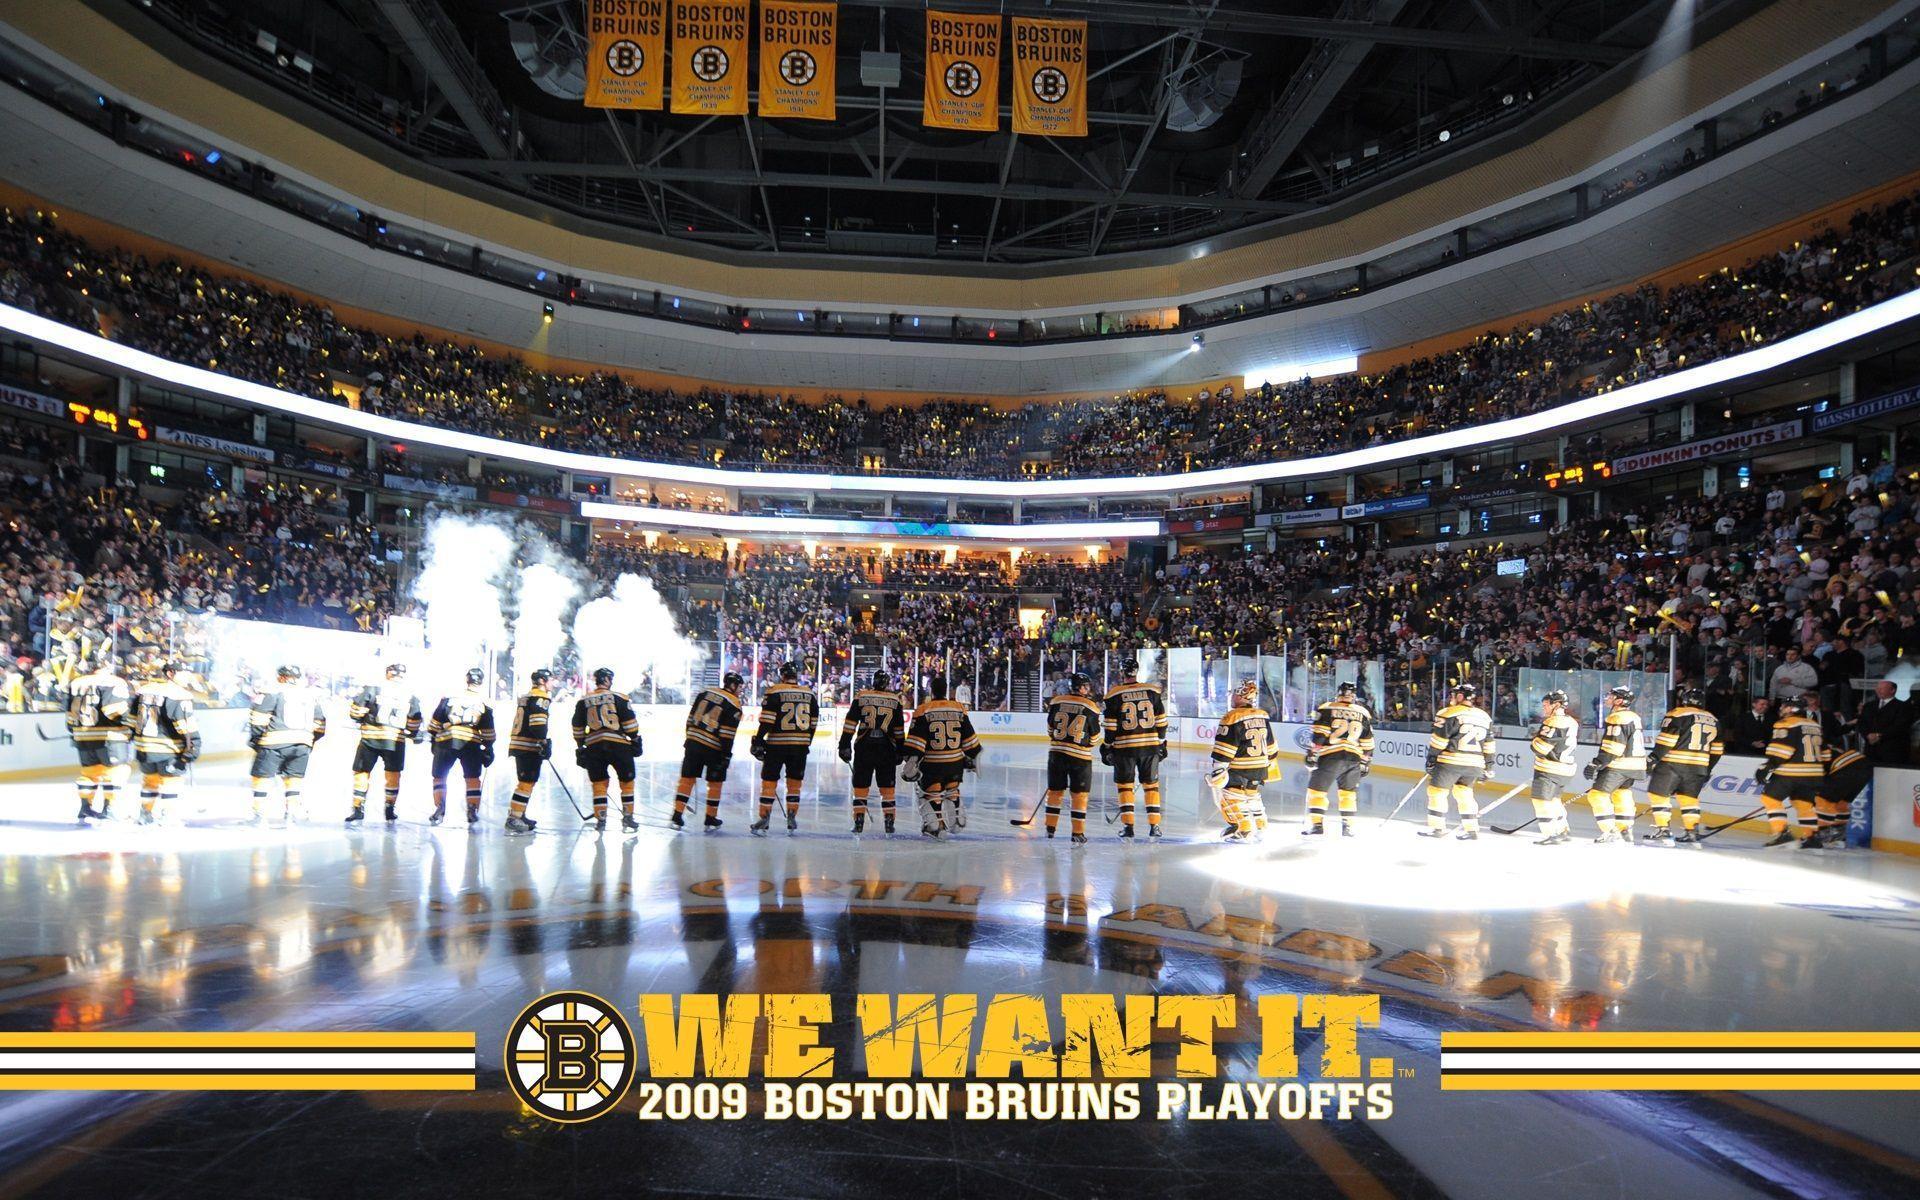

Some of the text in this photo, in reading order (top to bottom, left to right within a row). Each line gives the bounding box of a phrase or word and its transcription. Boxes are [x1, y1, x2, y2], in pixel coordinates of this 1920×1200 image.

[593, 0, 661, 17] BOSTON
[677, 5, 745, 22] BOSTON
[592, 18, 660, 36] BRUINS
[765, 9, 832, 27] BOSTON
[677, 24, 744, 41] BRUINS
[765, 28, 831, 46] BRUINS
[931, 20, 997, 38] BOSTON
[1017, 26, 1082, 45] BOSTON
[930, 37, 996, 57] BRUINS
[1018, 45, 1082, 63] BRUINS
[601, 79, 631, 87] STANLEY
[603, 87, 646, 95] CHAMPIONS
[942, 109, 982, 117] CHAMPIONS
[183, 433, 267, 460] NFS Leasing
[1627, 429, 1775, 471] DUNKIN' DONUTS
[781, 702, 811, 730] 26
[861, 705, 893, 731] 37
[1121, 700, 1155, 730] 33
[929, 720, 961, 750] 35
[1054, 711, 1086, 744] 34
[1689, 723, 1718, 751] 17
